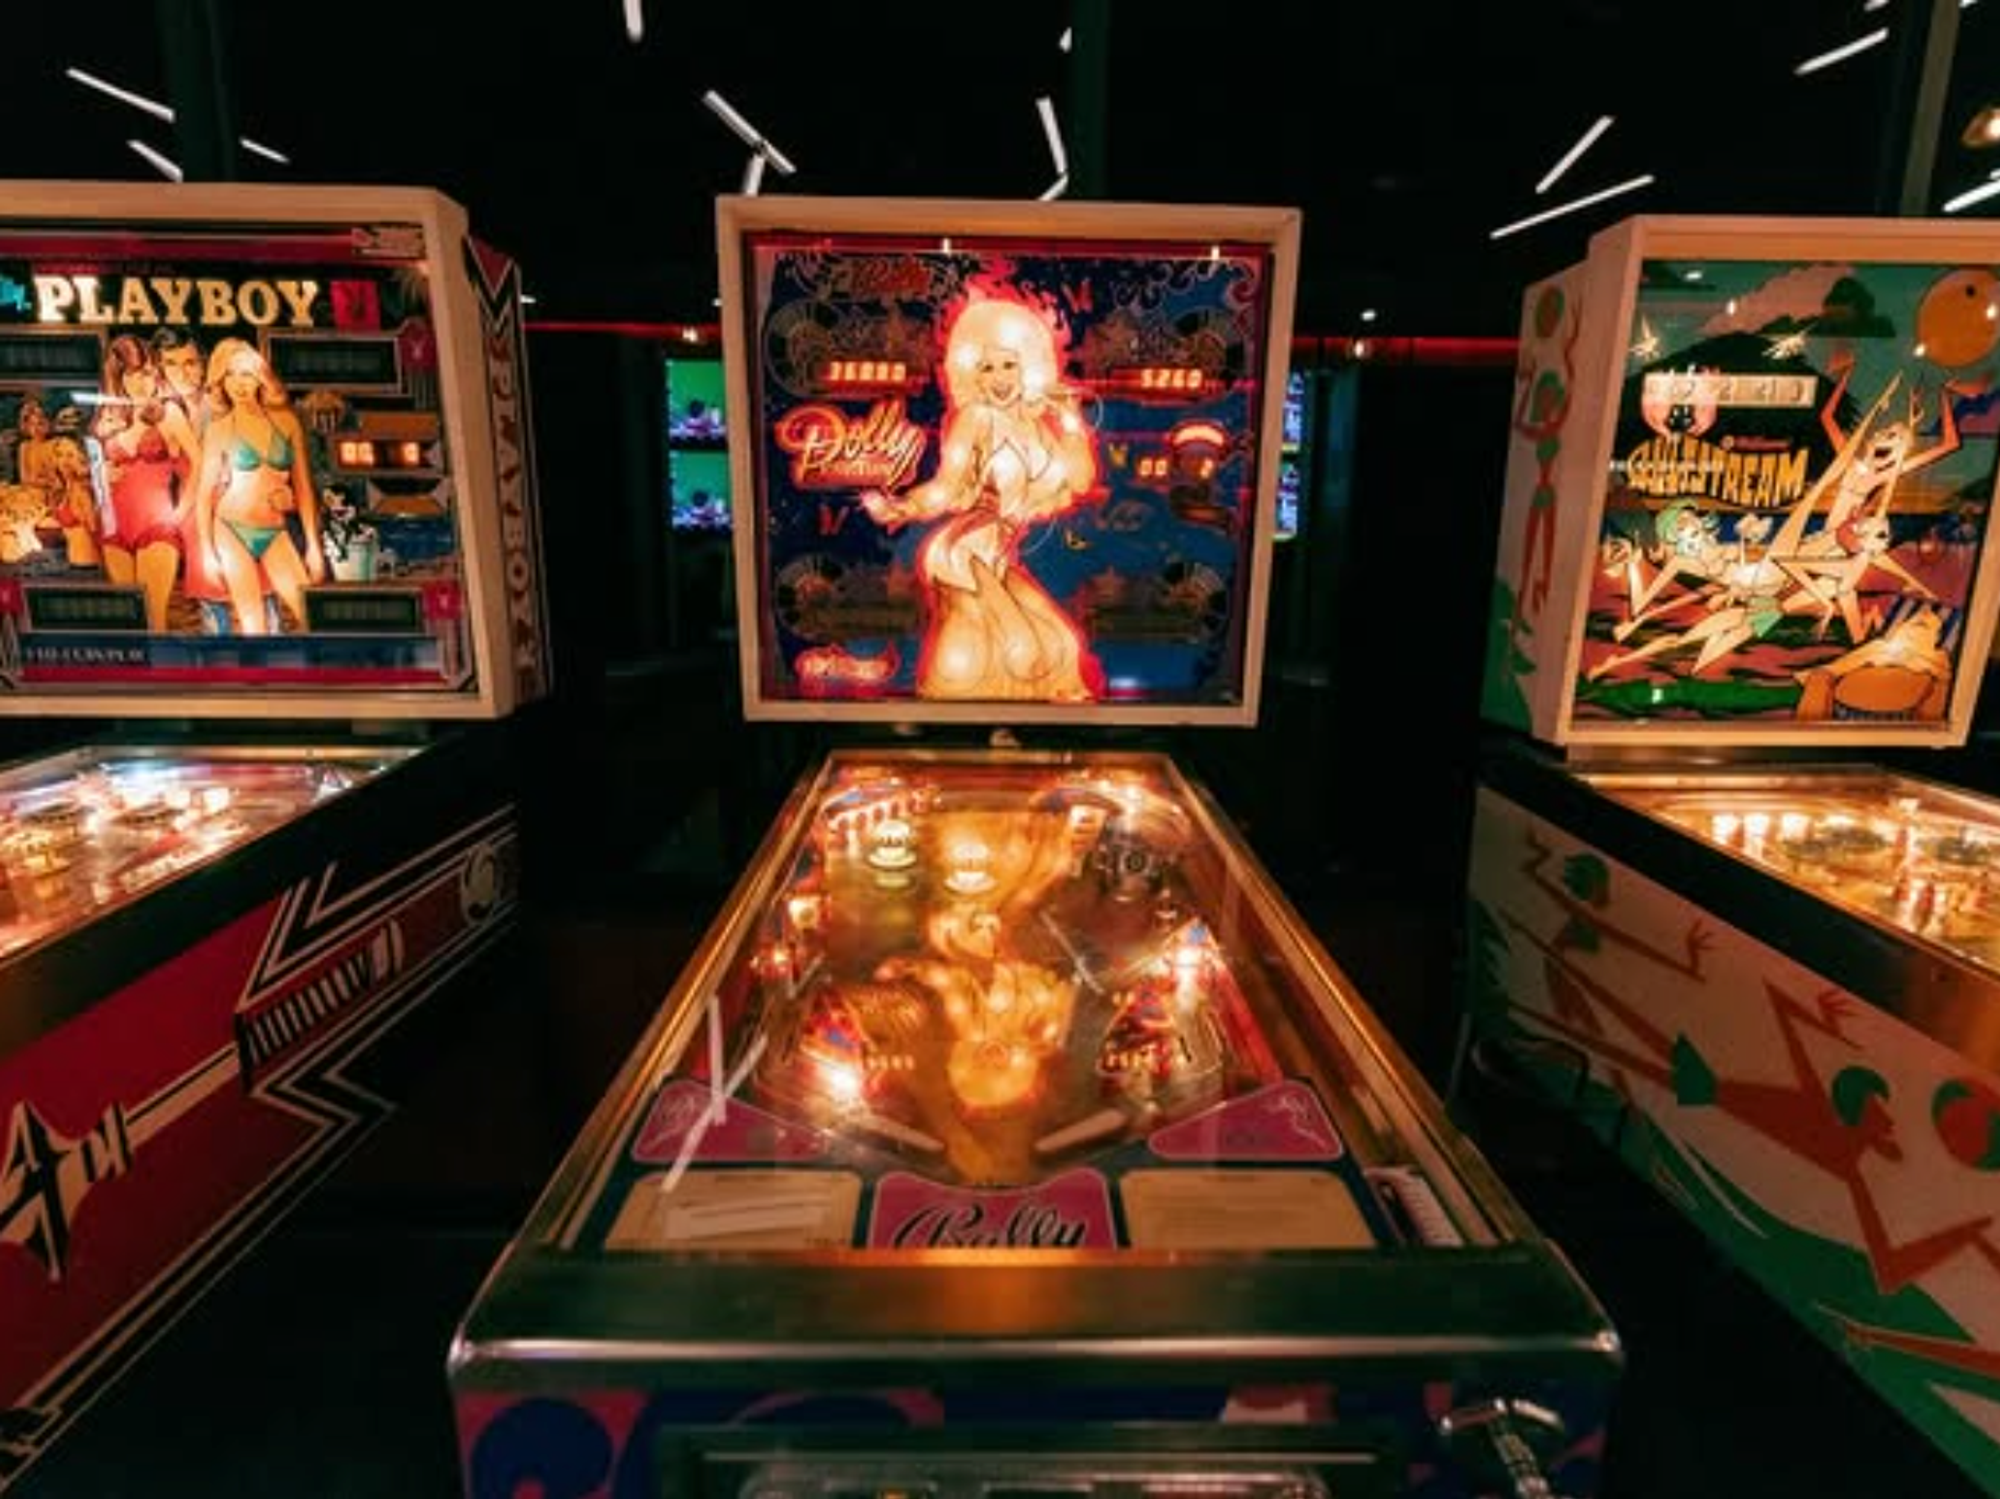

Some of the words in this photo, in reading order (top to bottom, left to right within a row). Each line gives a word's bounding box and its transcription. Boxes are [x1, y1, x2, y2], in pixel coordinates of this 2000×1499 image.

[33, 274, 319, 327] PLAYBOY
[775, 398, 922, 492] Dolly
[894, 1203, 1087, 1248] Bally
